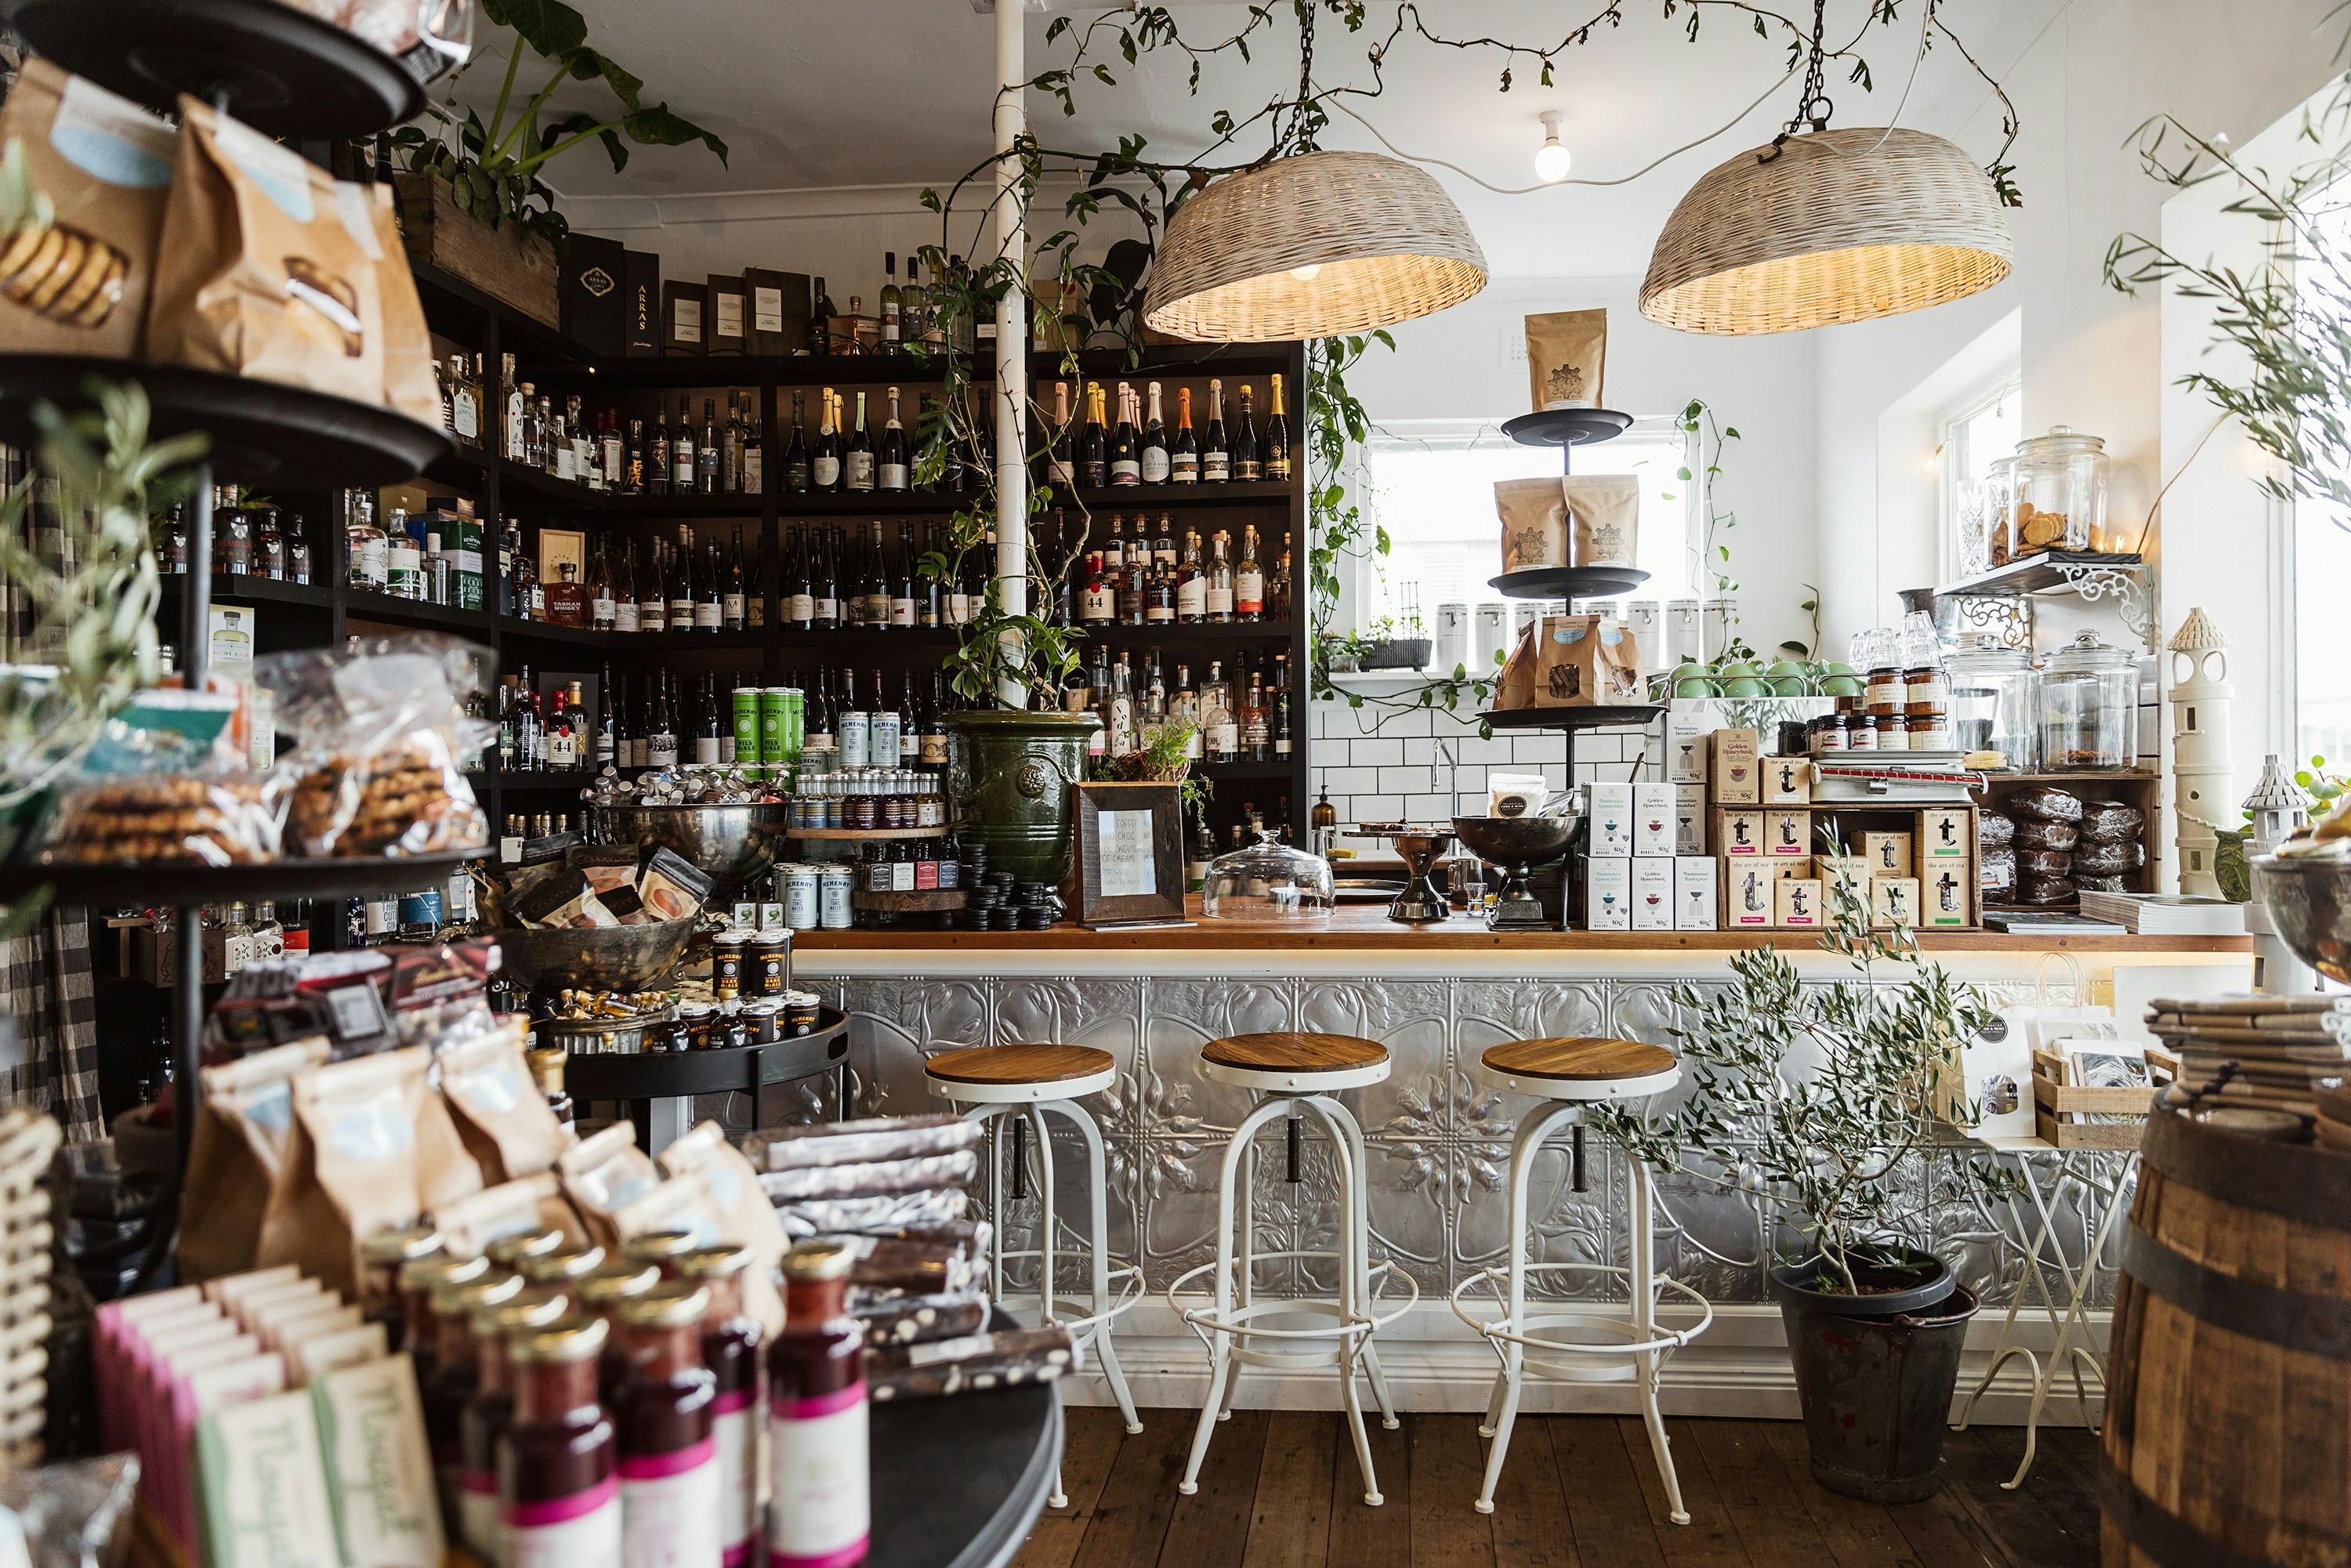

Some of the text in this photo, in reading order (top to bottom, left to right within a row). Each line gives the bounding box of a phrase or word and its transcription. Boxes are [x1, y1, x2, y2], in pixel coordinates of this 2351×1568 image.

[1088, 597, 1103, 607] 44
[553, 741, 571, 752] 44
[1118, 831, 1135, 840] CHOC
